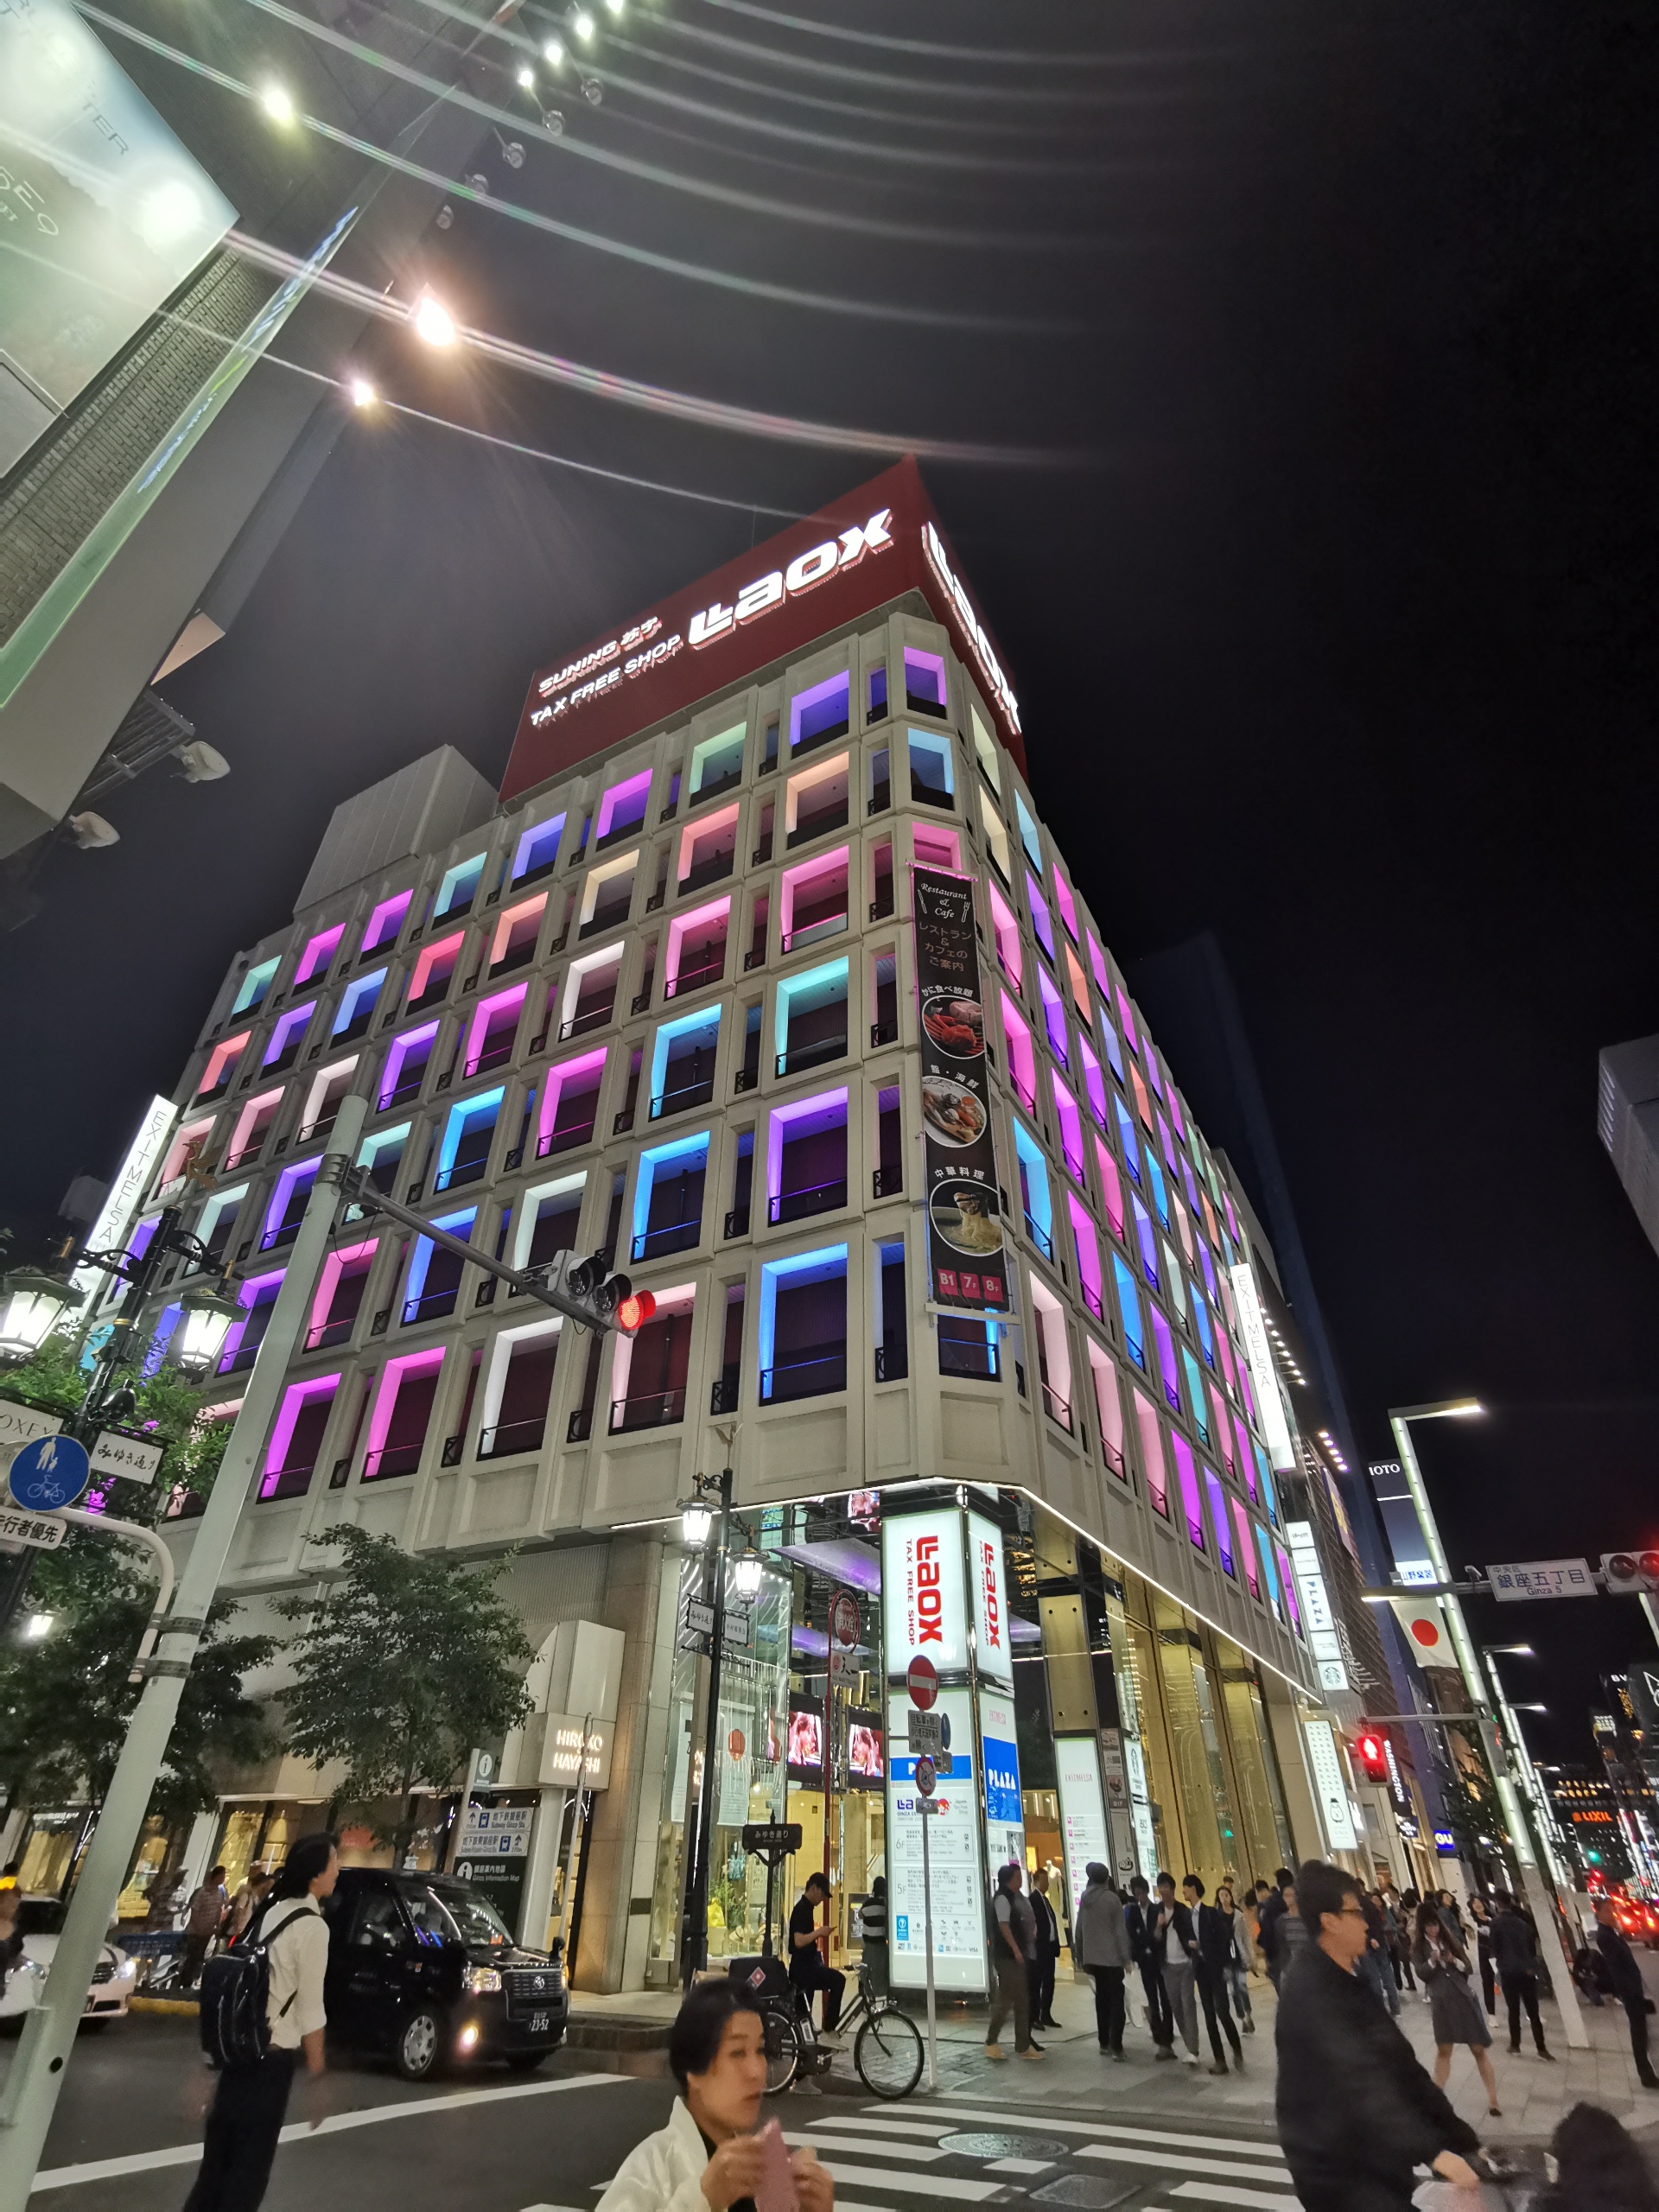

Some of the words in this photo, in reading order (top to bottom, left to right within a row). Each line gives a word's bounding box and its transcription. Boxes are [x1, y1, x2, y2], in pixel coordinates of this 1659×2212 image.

[538, 640, 618, 693] SUNING
[531, 696, 568, 726] TAX
[570, 666, 621, 704] FREE
[624, 634, 681, 674] SHOP
[921, 882, 968, 899] Restaurant
[935, 907, 955, 918] Cafe
[919, 921, 972, 940] レストラン
[925, 943, 968, 958] カフェの
[930, 957, 964, 971] ご案内
[921, 985, 974, 997] かに食べ放題
[99, 1110, 168, 1243] EXITMELSA
[934, 1166, 985, 1180] 中華料理
[1237, 1274, 1272, 1388] EXITMELSA
[98, 1444, 156, 1470] みゆき通り
[1493, 1565, 1521, 1573] 中央区
[1497, 1568, 1586, 1589] 銀座五丁目
[1527, 1587, 1553, 1596] Ginza
[1306, 1580, 1324, 1624] PLAZA
[988, 1768, 1016, 1790] PLAZA
[1383, 1739, 1405, 1802] WASHINGTON
[1434, 1833, 1454, 1845] GU
